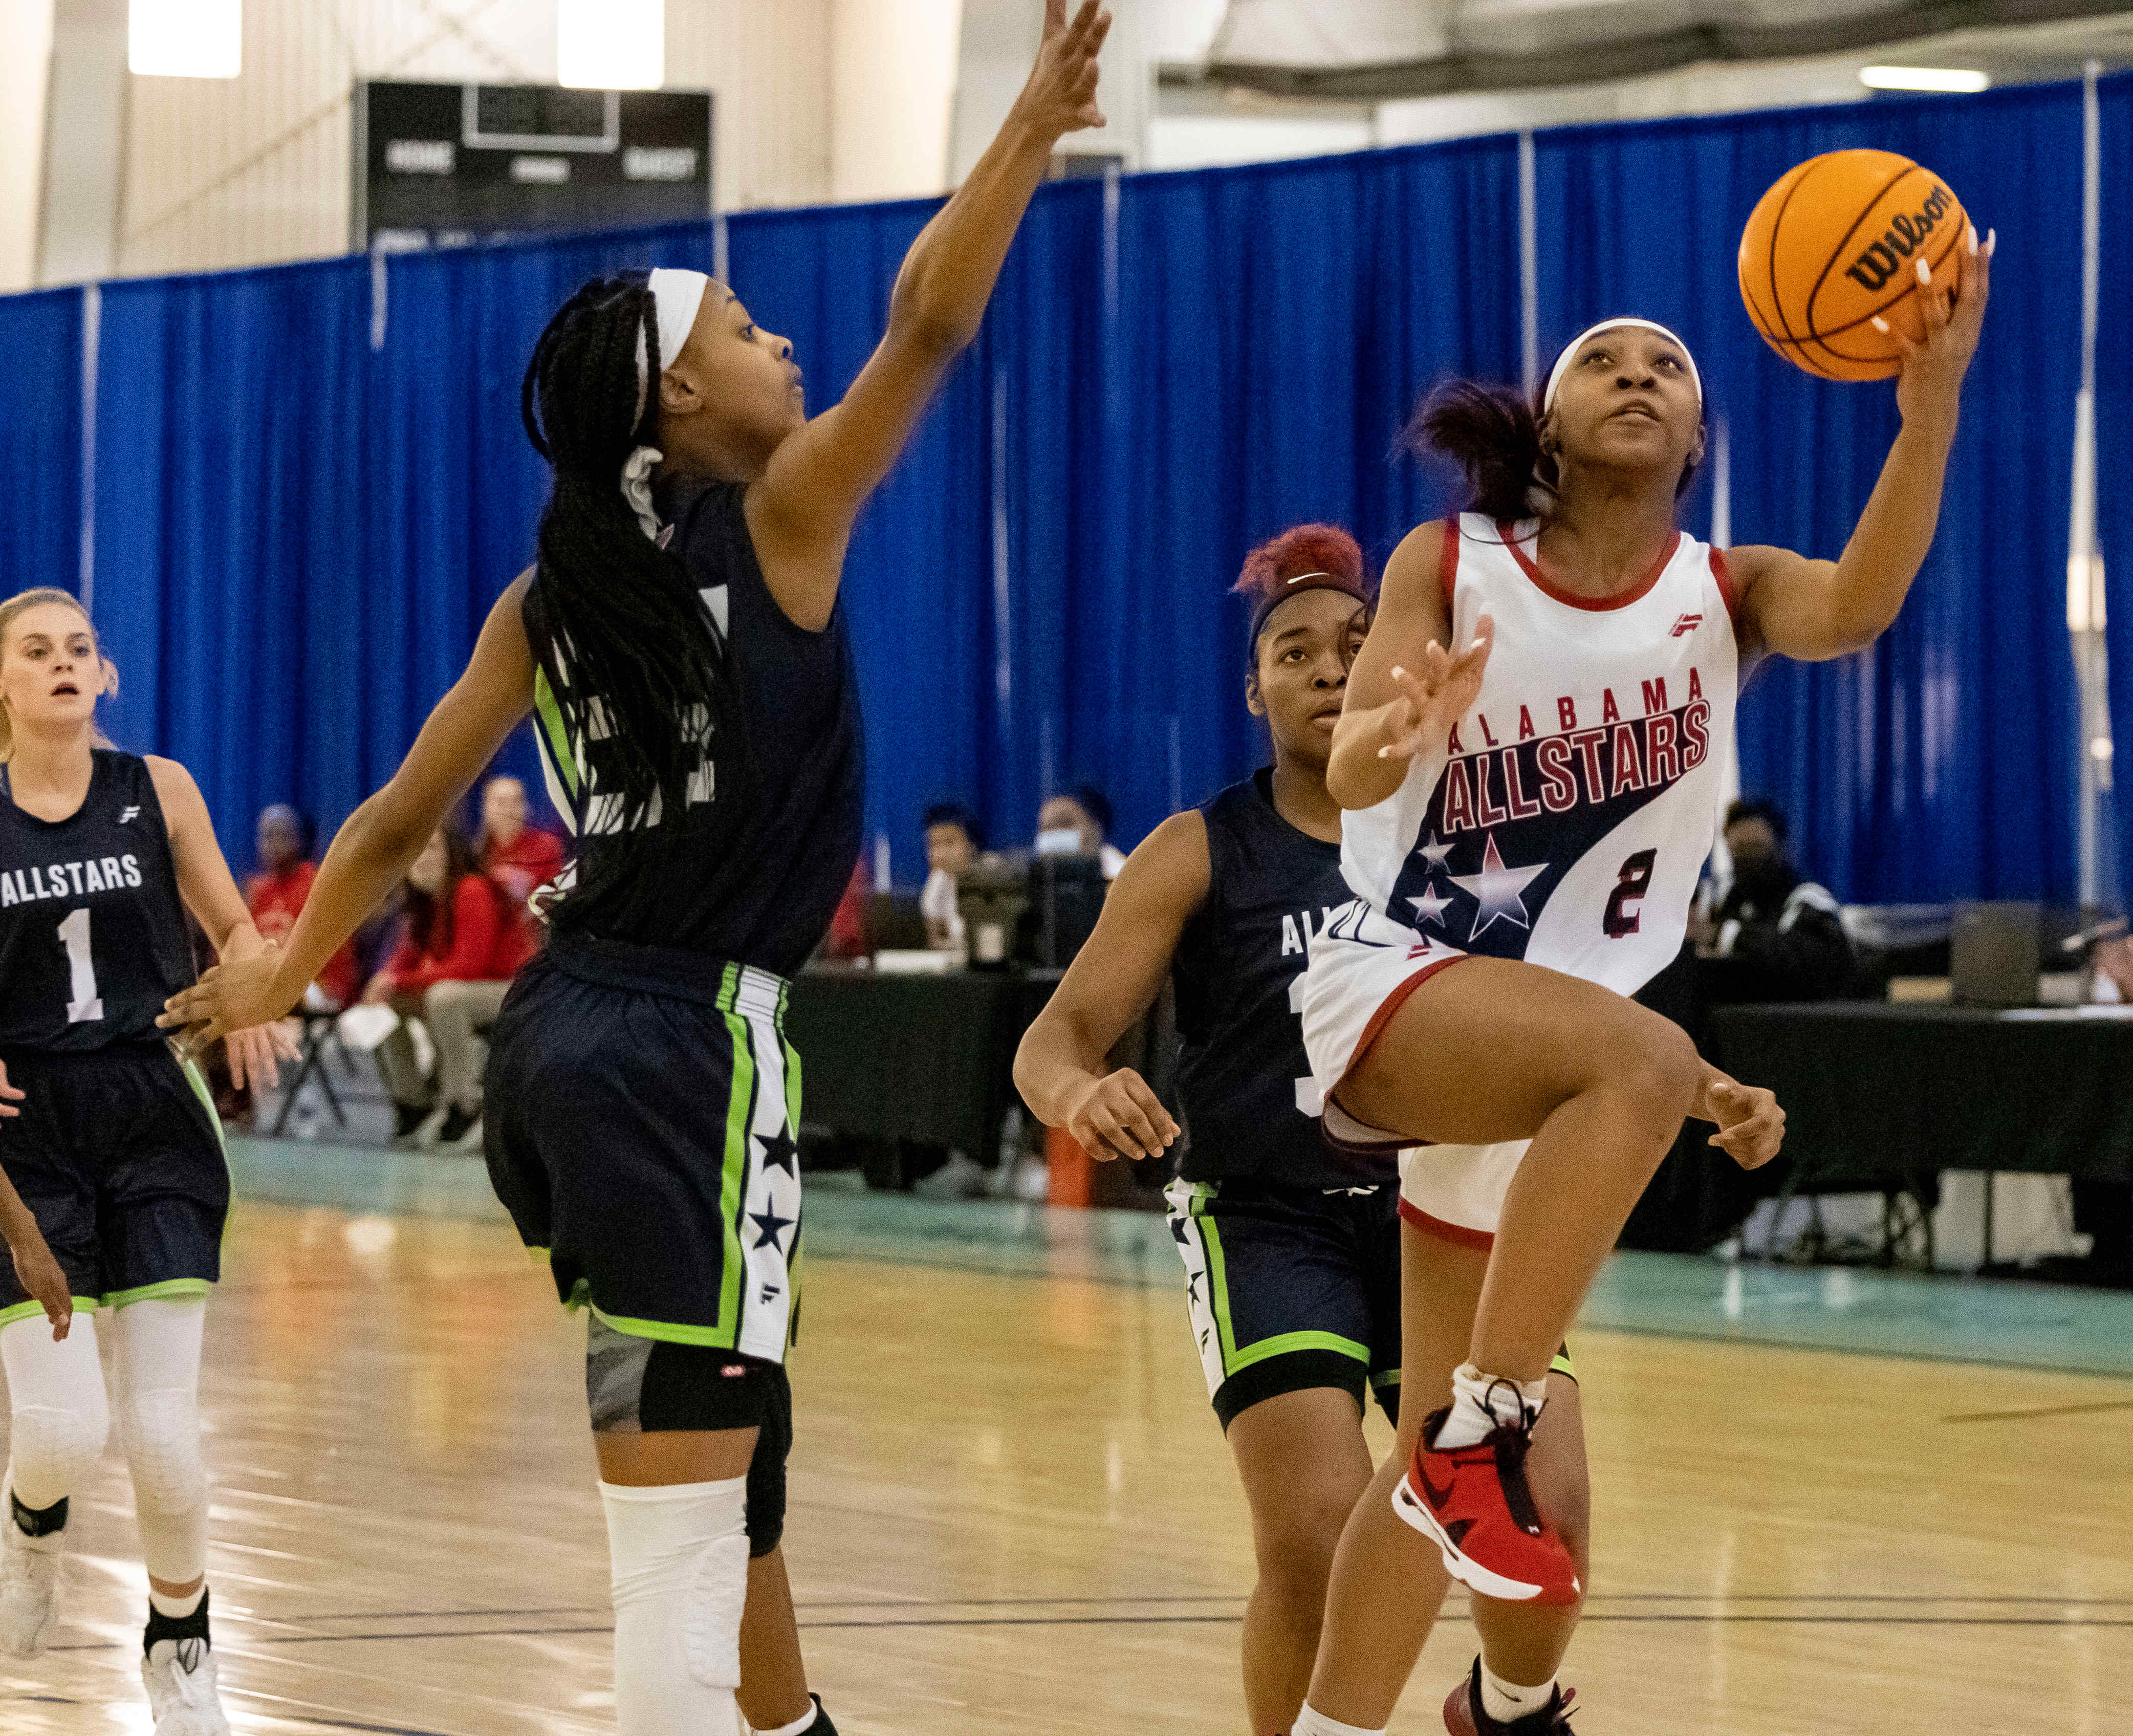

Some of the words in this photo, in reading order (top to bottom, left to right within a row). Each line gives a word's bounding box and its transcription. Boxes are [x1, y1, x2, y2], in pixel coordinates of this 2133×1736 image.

[1844, 184, 1952, 291] Wilson
[1447, 666, 1703, 755] ALABAMA
[1443, 699, 1711, 834] ALLSTARS
[0, 854, 142, 907] ALLSTARS
[1602, 848, 1657, 939] 2
[57, 908, 103, 1023] 1
